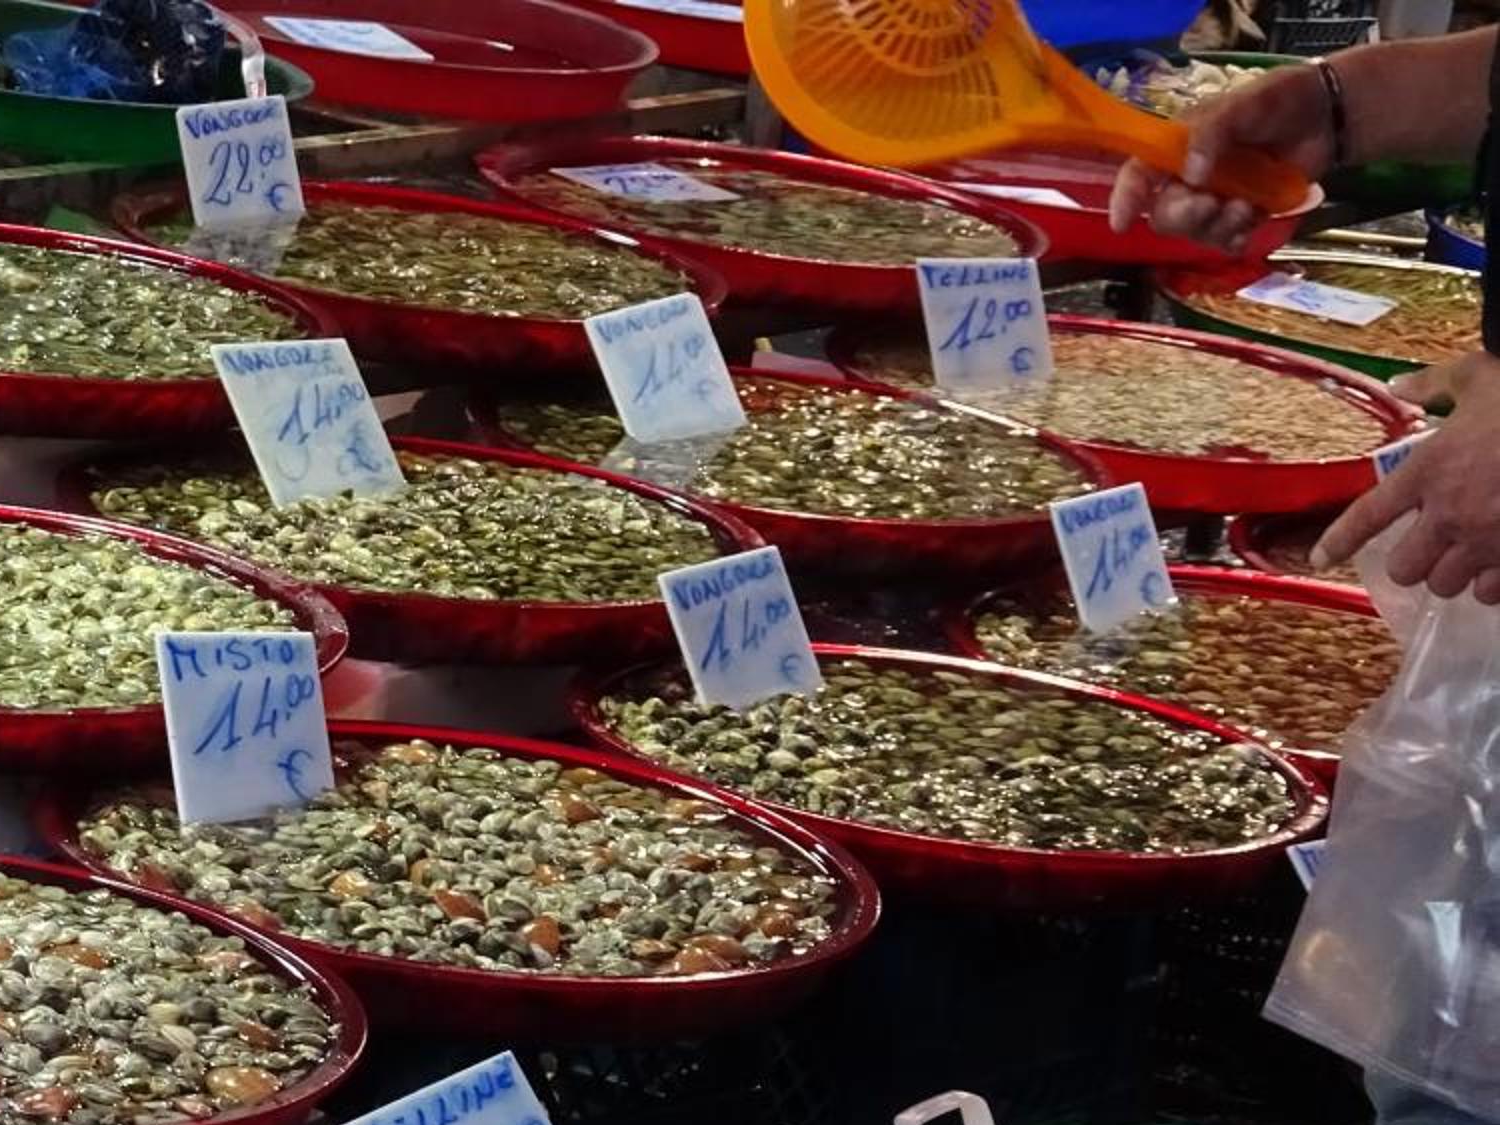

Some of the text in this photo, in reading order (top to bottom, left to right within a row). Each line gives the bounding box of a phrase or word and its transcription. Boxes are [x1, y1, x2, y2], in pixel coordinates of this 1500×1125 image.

[165, 636, 294, 682] MISTO
[193, 673, 314, 755] 14,00
[277, 748, 314, 801] €
